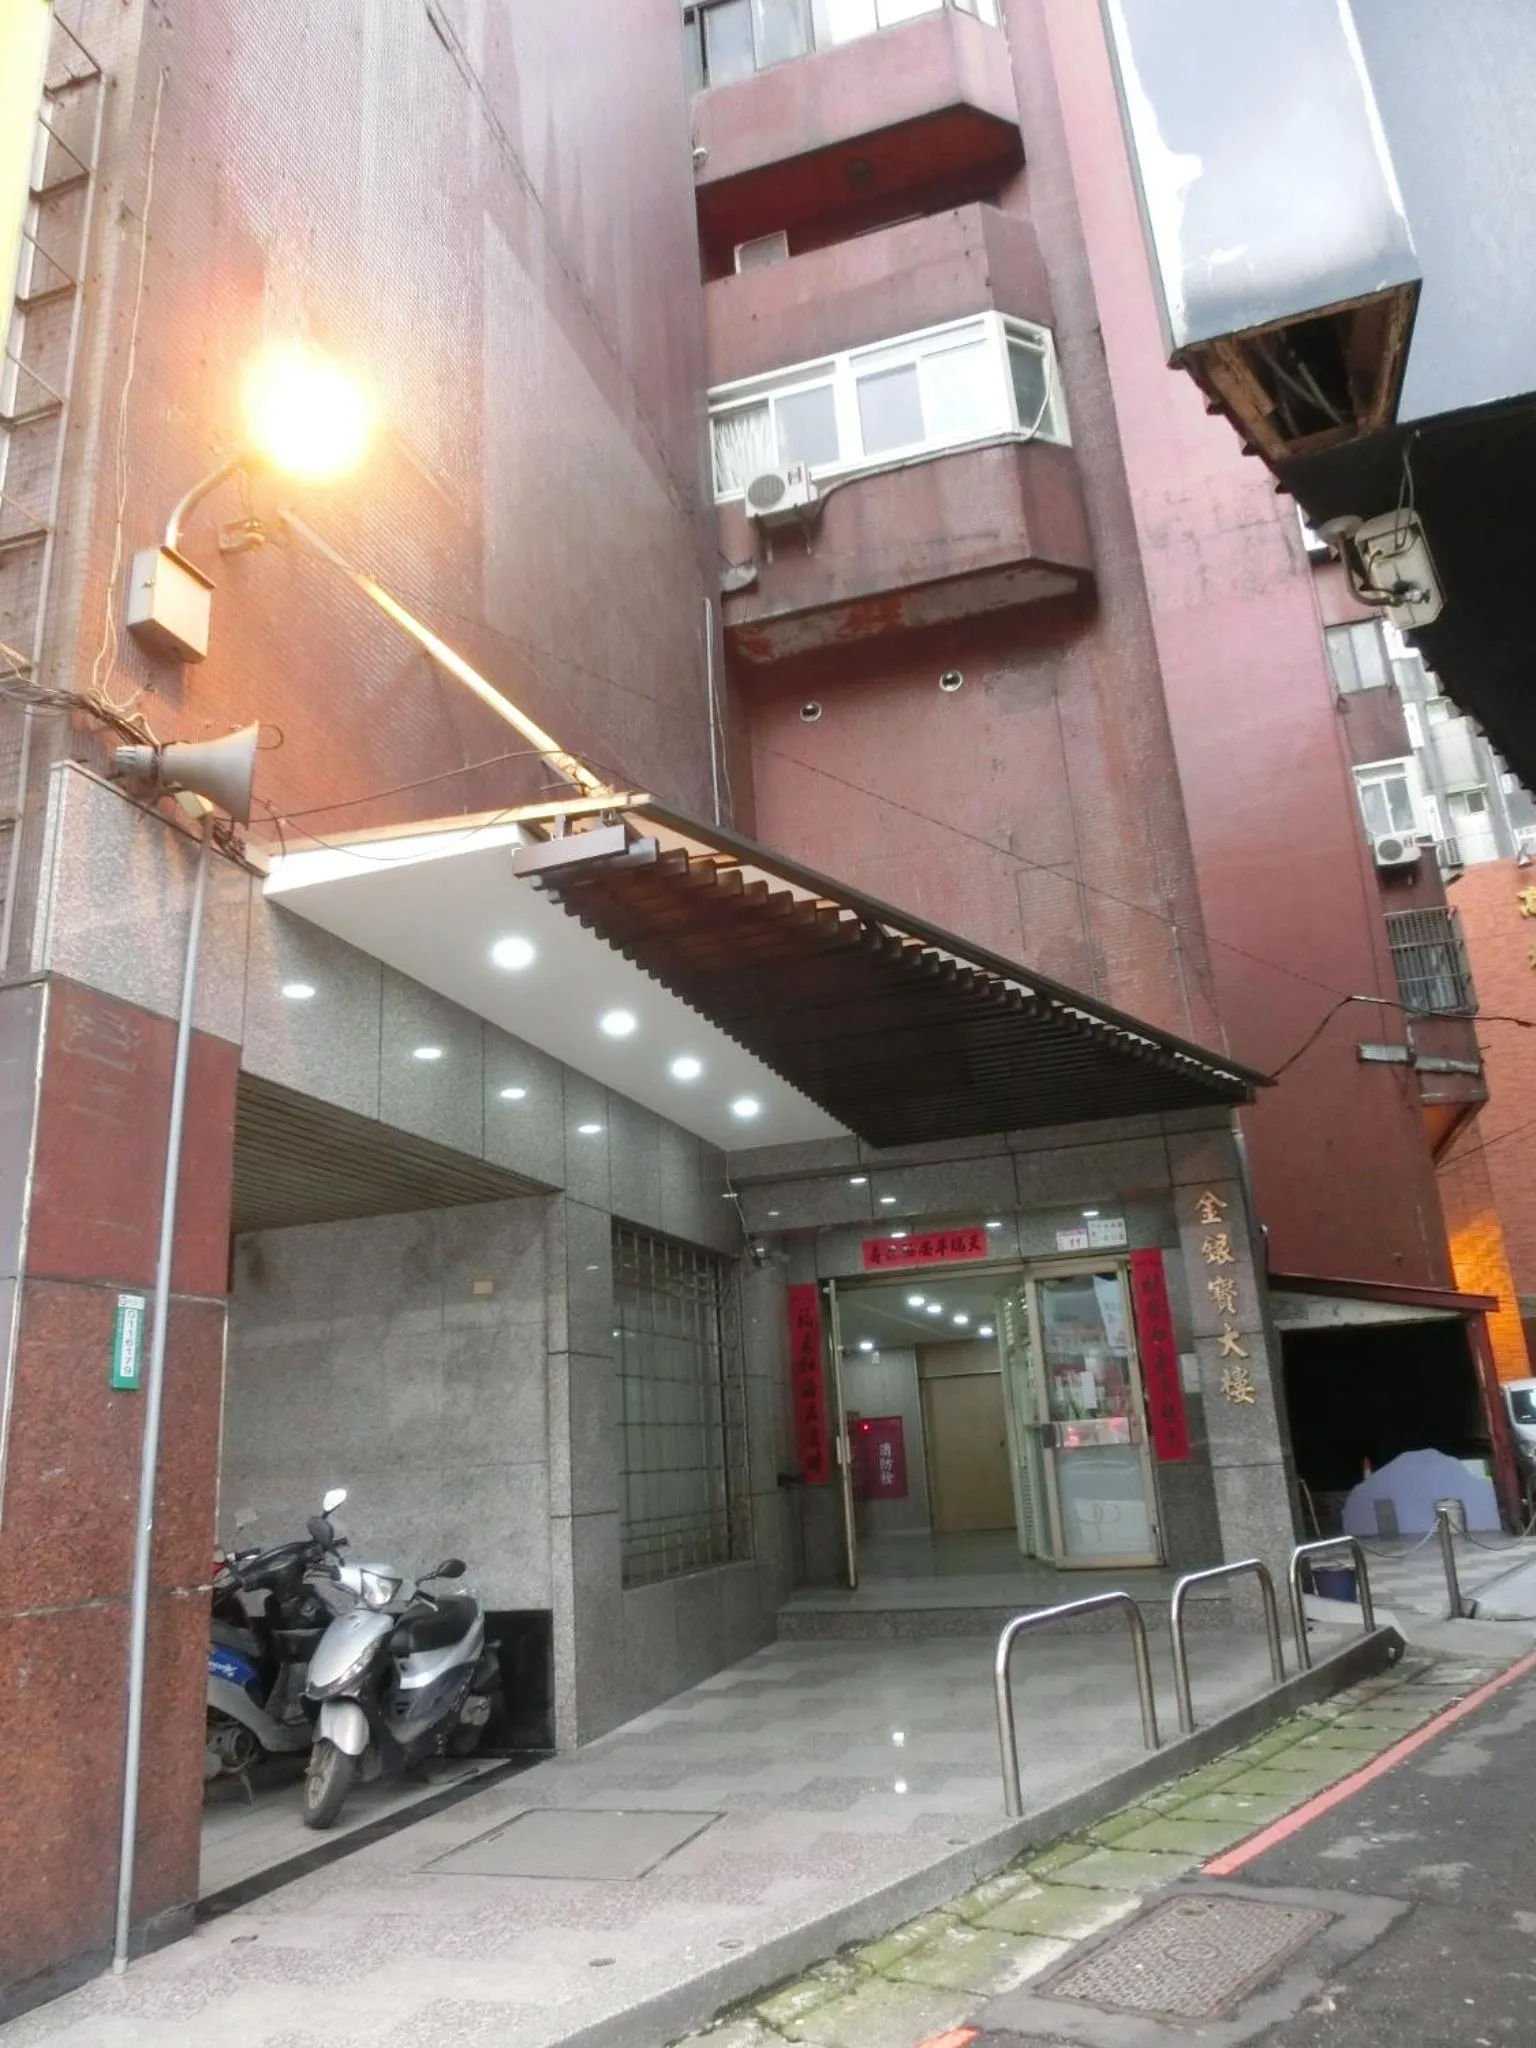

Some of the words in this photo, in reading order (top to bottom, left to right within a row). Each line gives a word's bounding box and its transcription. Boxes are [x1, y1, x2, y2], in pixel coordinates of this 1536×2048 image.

[1194, 1190, 1256, 1405] 金銀寶大樓
